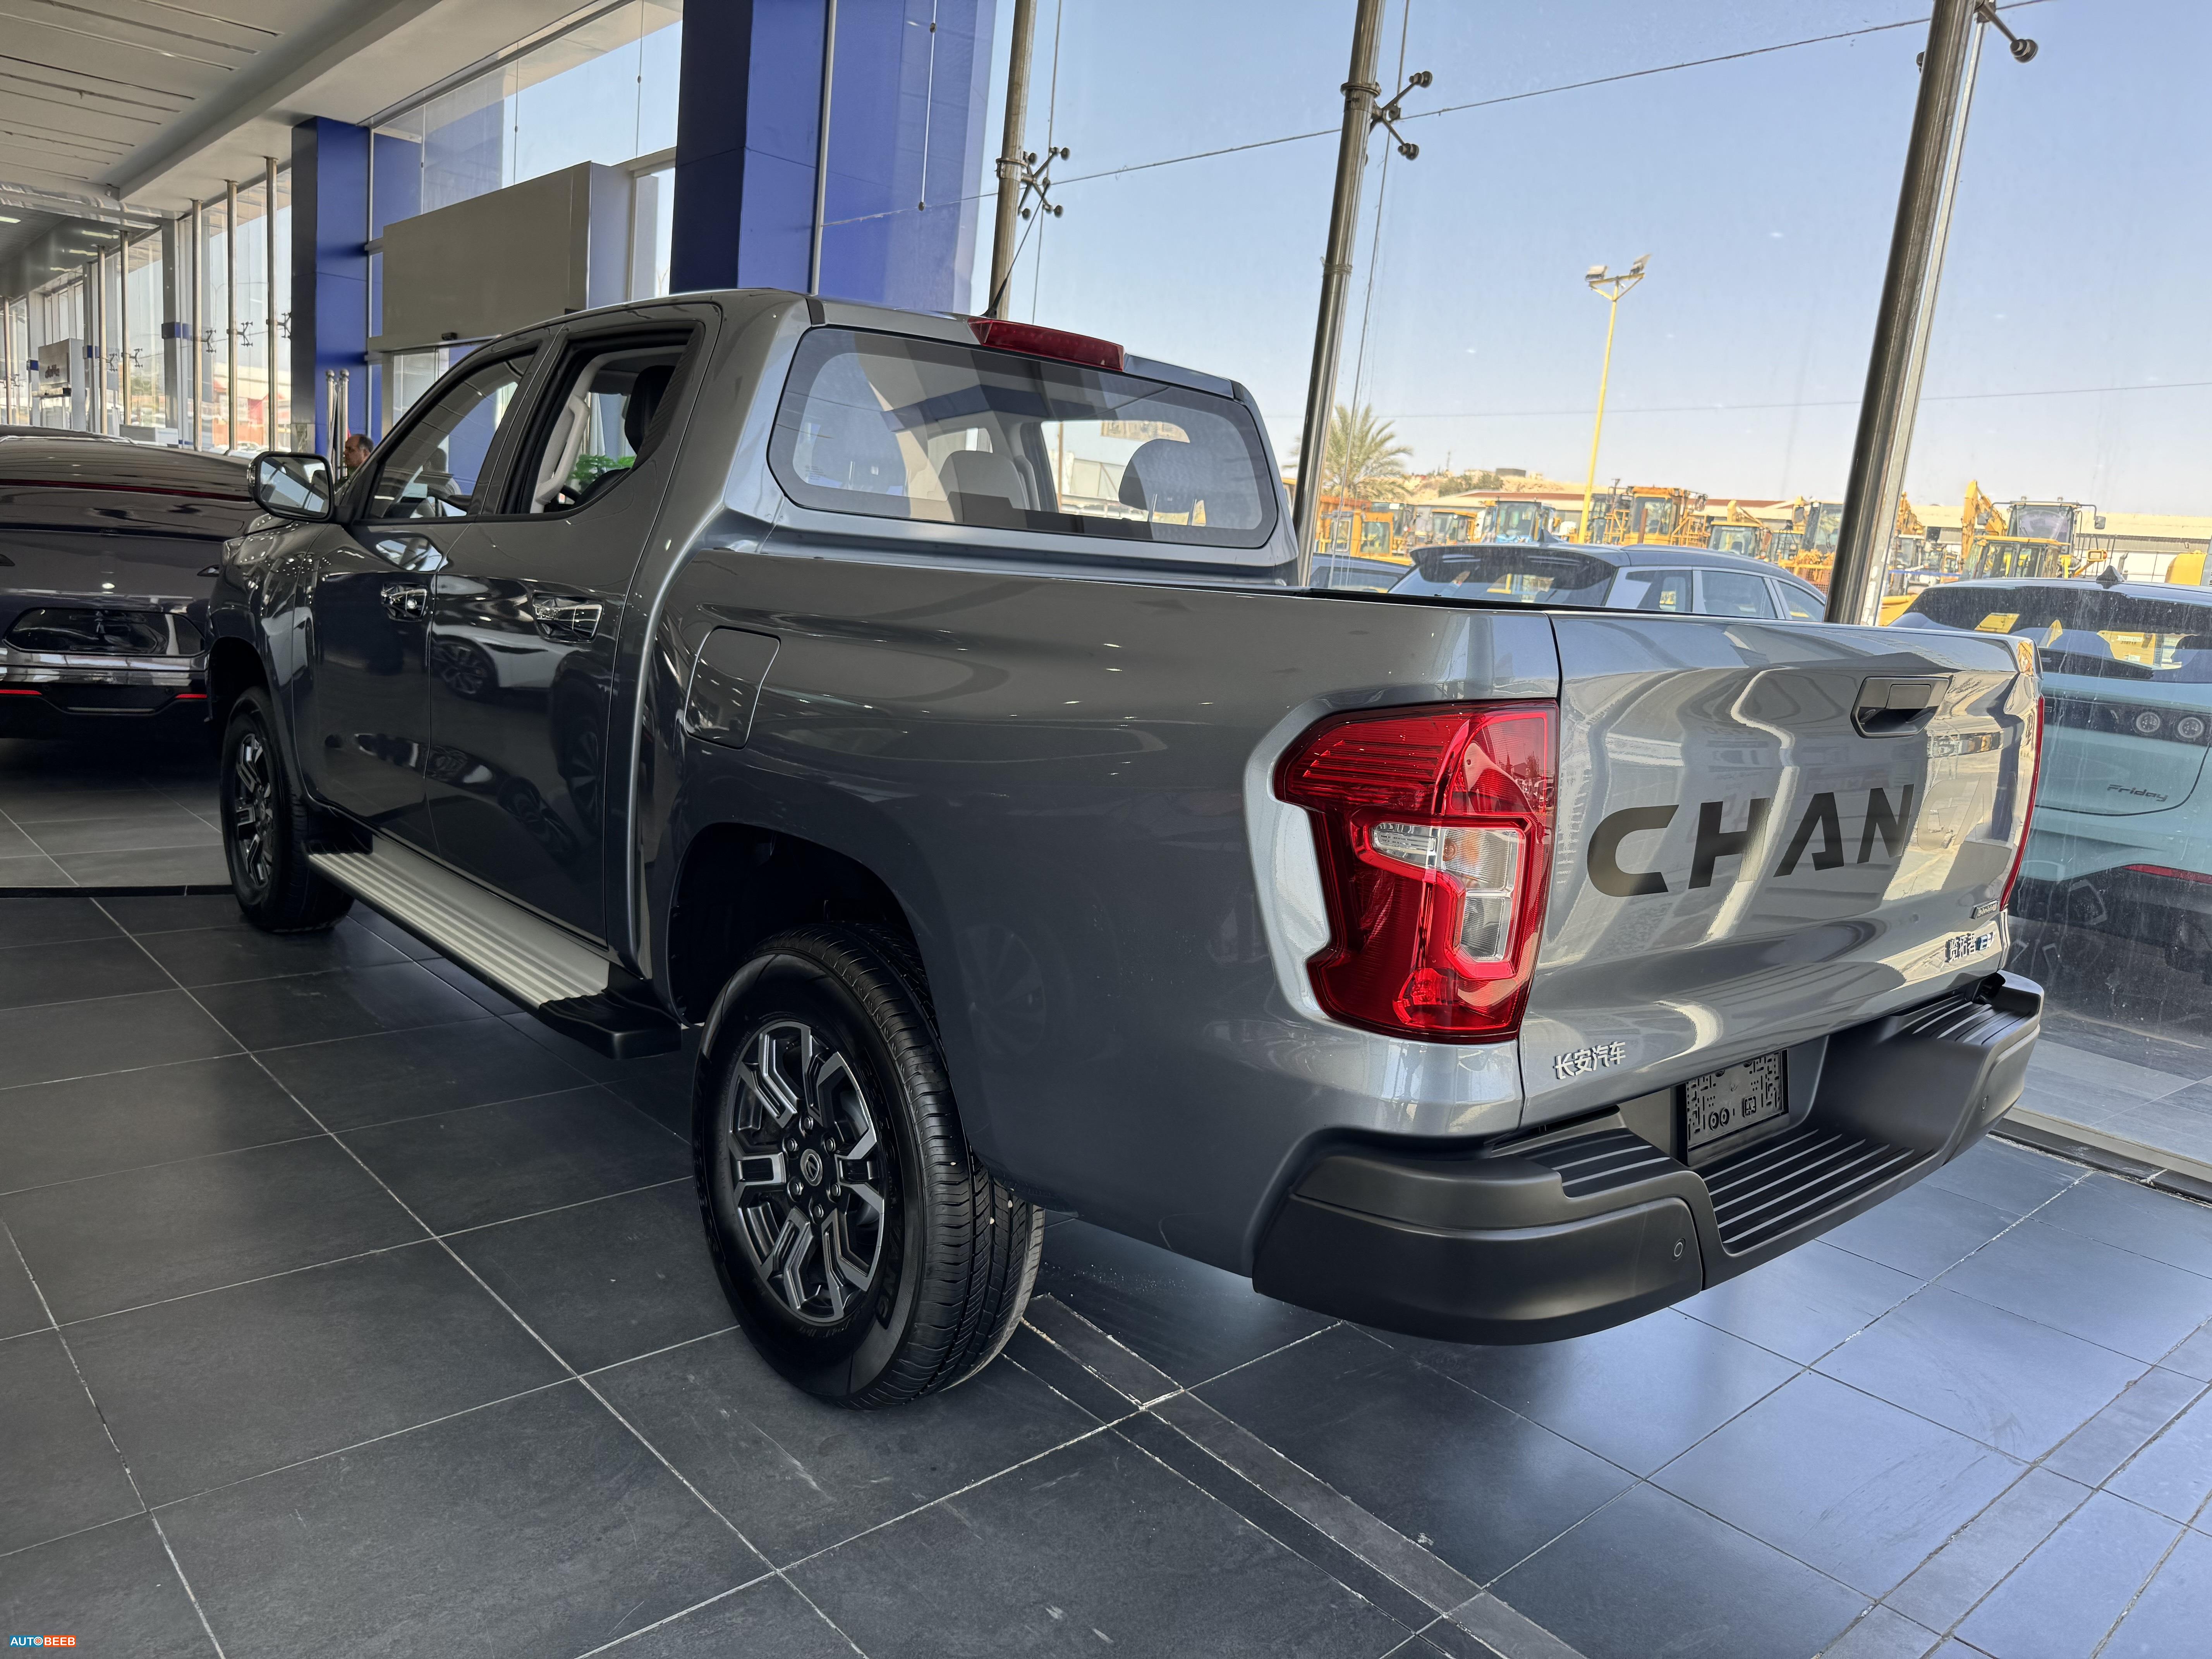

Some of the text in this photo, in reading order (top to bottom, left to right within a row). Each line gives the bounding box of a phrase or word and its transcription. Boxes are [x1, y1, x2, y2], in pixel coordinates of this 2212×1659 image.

[2107, 784, 2168, 802] Friday
[1554, 1041, 1626, 1080] 长安汽车
